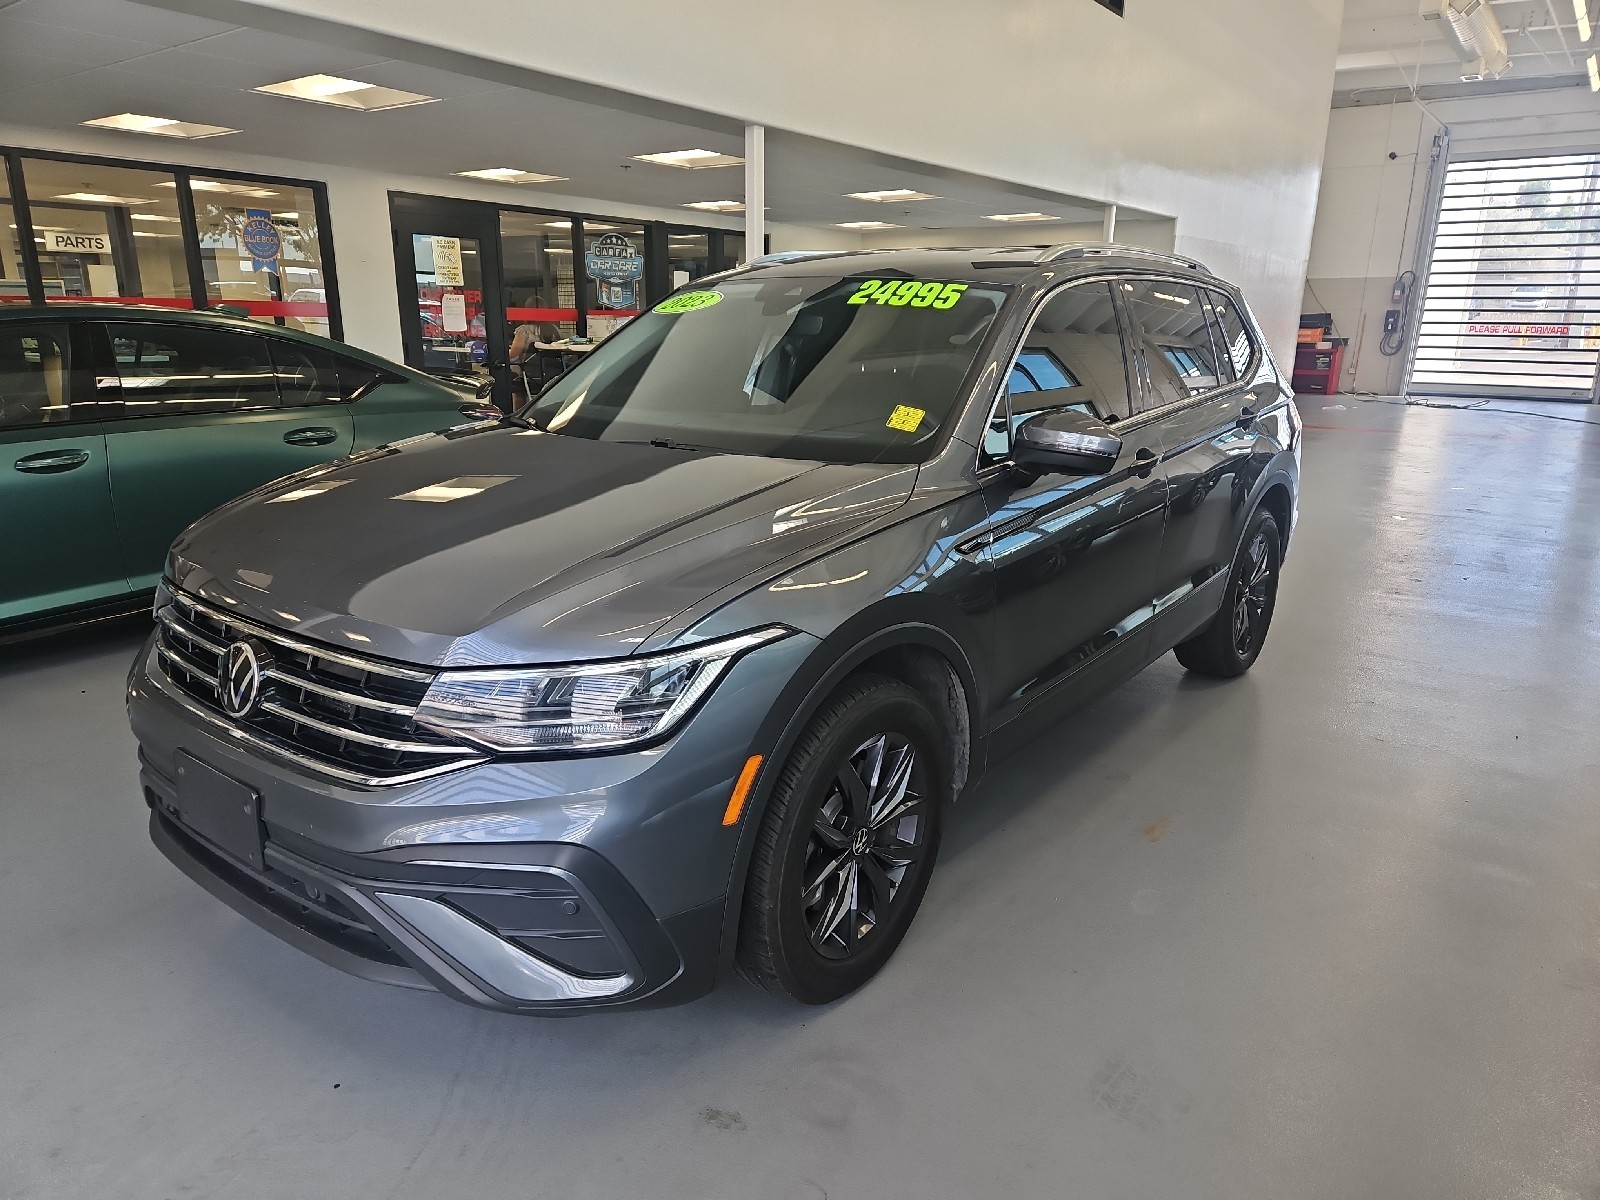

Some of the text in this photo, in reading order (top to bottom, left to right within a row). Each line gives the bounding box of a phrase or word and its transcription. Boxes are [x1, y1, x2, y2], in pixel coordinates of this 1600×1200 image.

[246, 221, 275, 234] KELLEY
[55, 235, 105, 250] PARTS
[244, 234, 279, 244] BLUE BOOK
[595, 247, 635, 259] CARFAX
[590, 259, 639, 272] CAR CARE
[846, 279, 969, 310] 24995
[1468, 325, 1569, 336] PLEASE PULL FORWARD
